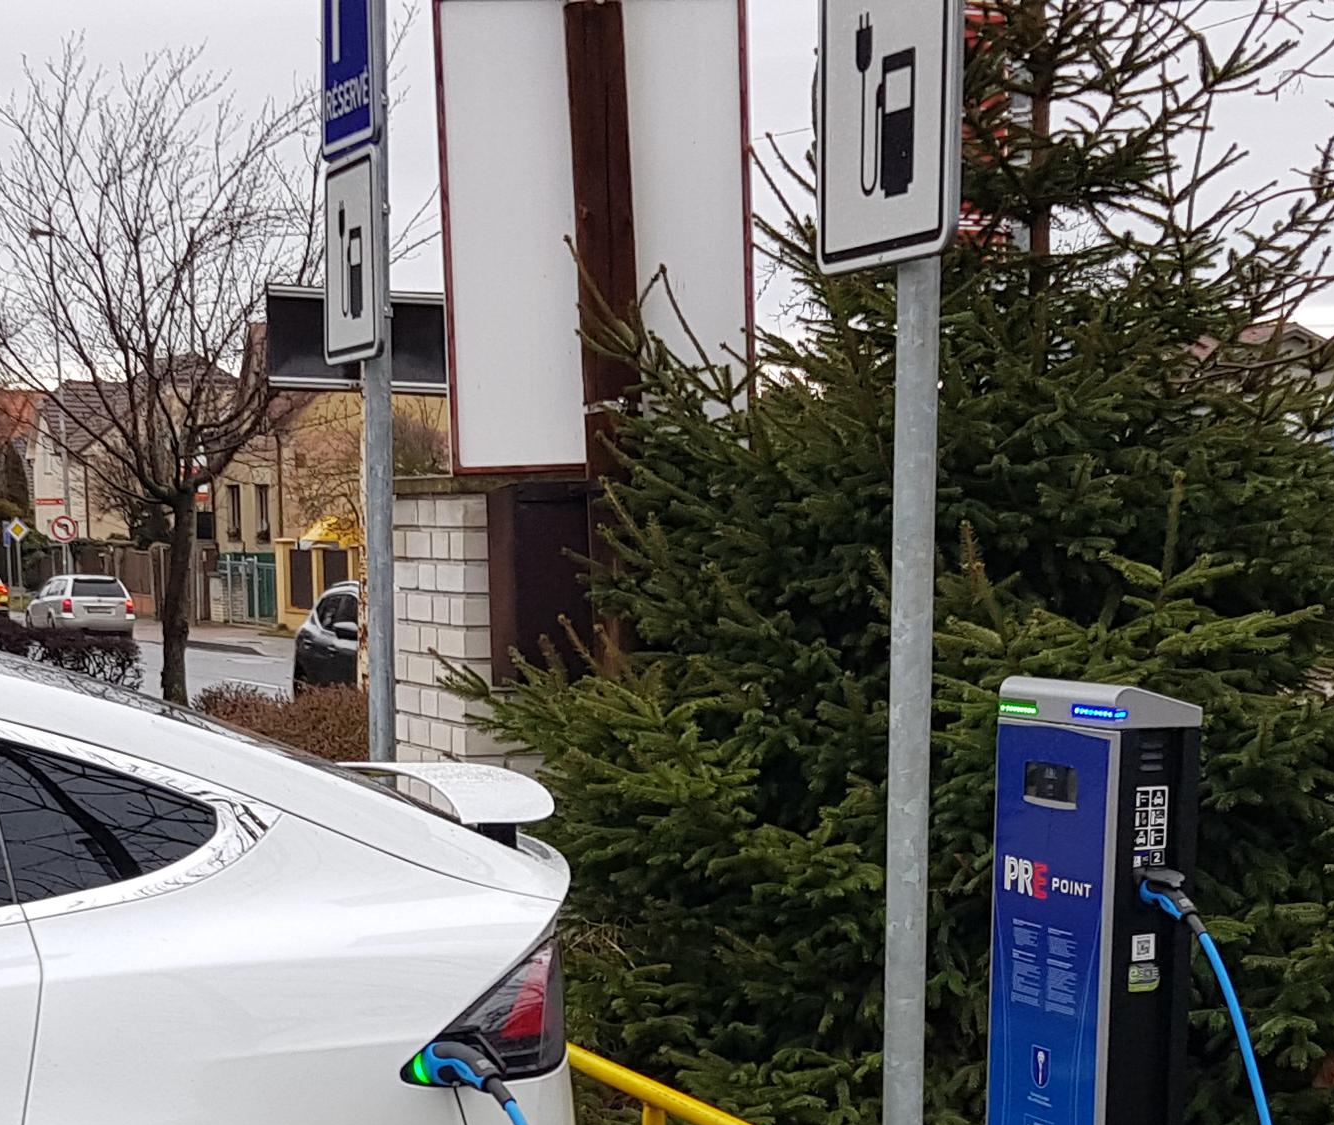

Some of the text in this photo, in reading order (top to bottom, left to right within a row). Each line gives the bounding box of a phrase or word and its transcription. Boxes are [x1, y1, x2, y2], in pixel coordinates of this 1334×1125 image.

[326, 65, 369, 120] RÉSERVÉ
[1004, 854, 1092, 899] PRE POINT
[1153, 852, 1161, 862] 2
